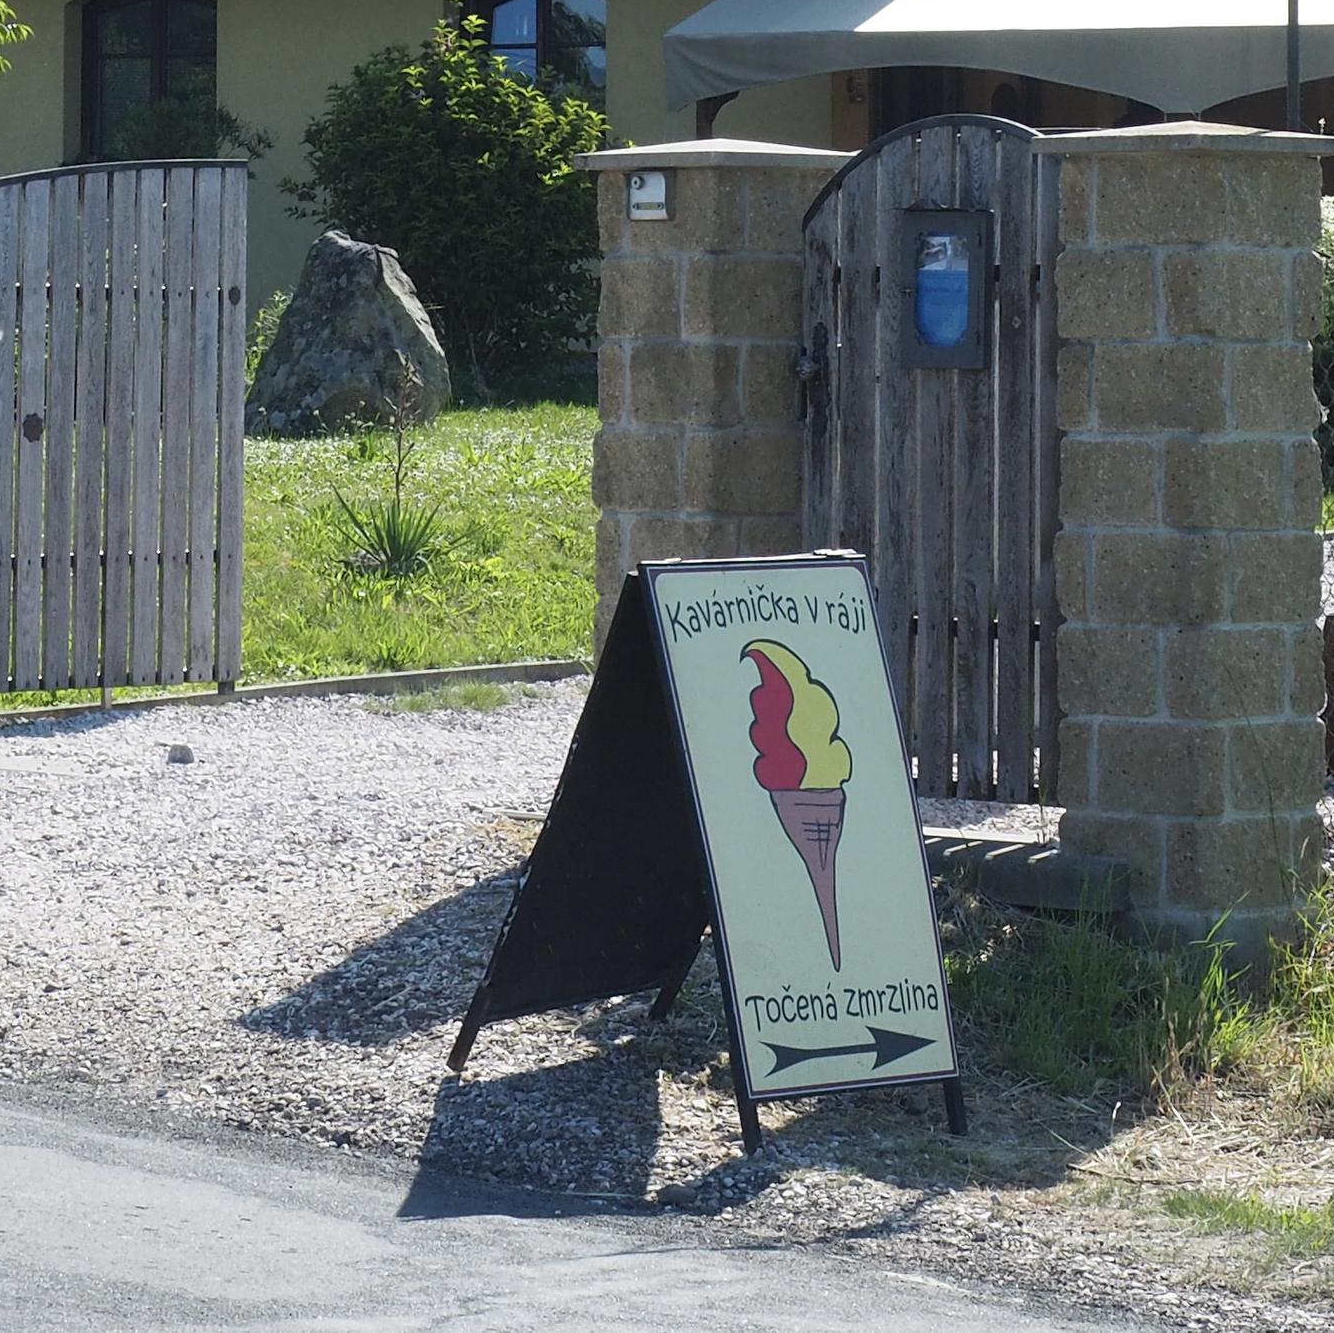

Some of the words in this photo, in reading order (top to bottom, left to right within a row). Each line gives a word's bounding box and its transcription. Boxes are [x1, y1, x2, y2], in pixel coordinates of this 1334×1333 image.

[665, 584, 800, 643] Kavárnička
[825, 592, 867, 634] ráji
[745, 982, 838, 1033] Točená
[843, 978, 939, 1019] zmrzlina
